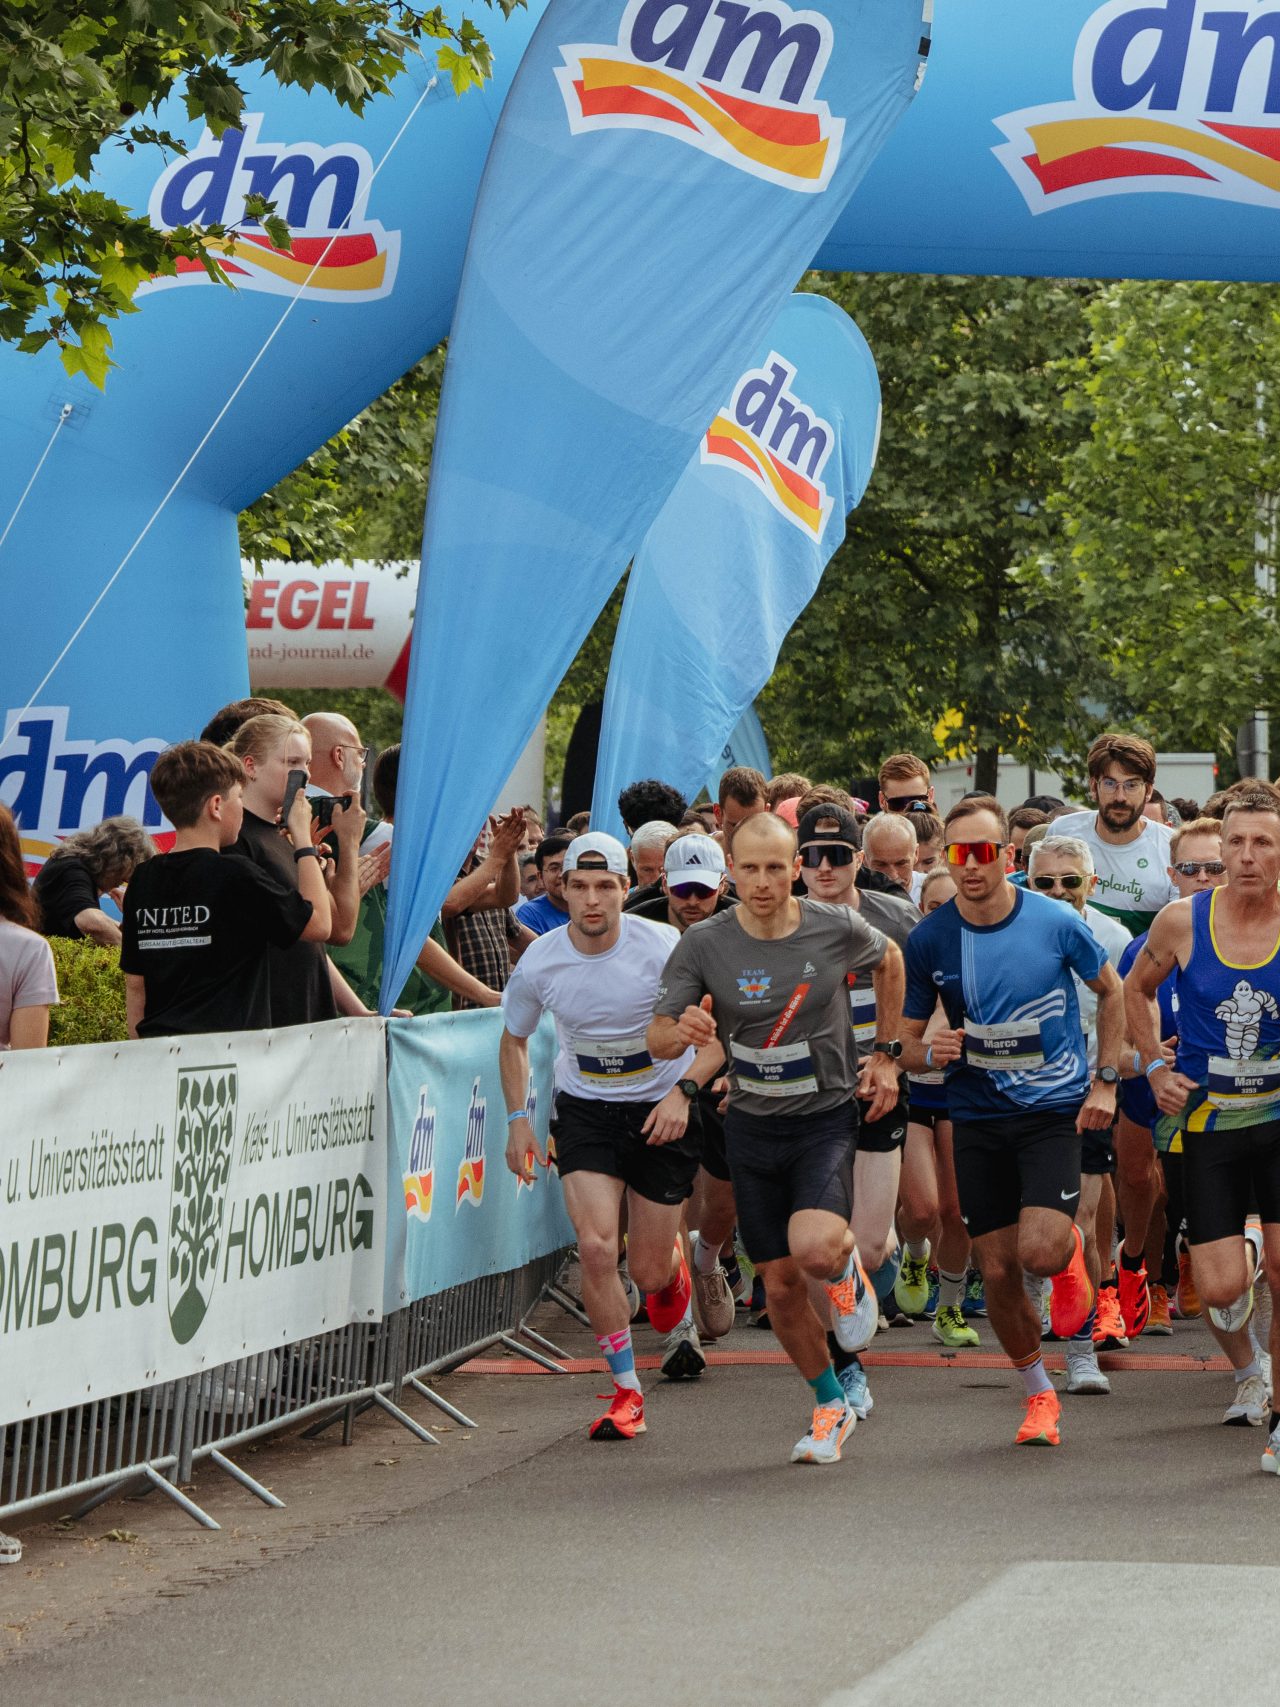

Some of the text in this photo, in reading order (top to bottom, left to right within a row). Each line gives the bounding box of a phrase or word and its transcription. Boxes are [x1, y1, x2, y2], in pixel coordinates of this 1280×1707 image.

[161, 124, 359, 229] dm
[735, 362, 827, 480] dm
[246, 580, 375, 630] EGEL
[250, 643, 374, 663] nd-journal.de
[0, 720, 163, 830] dm
[598, 1056, 624, 1067] Théo
[756, 1064, 784, 1073] Yves
[983, 1039, 1018, 1049] Marco
[1234, 1076, 1264, 1087] Marc
[271, 1119, 282, 1160] u.
[285, 1092, 375, 1157] Universitätsstadt
[409, 1094, 434, 1174] dm
[466, 1085, 485, 1160] dm
[7, 1123, 165, 1204] u. Universitätsstadt
[223, 1173, 374, 1284] HOMBURG
